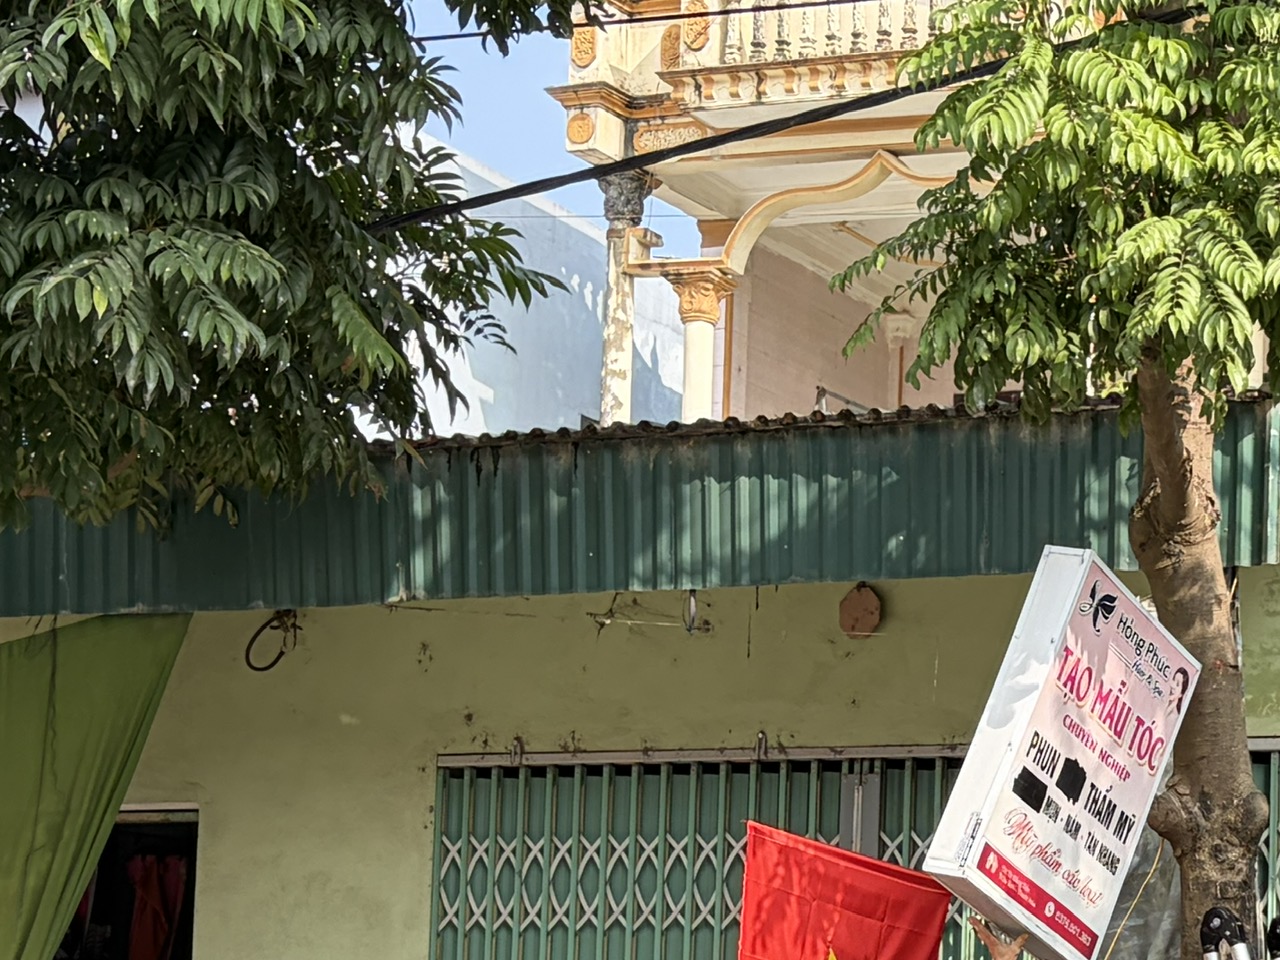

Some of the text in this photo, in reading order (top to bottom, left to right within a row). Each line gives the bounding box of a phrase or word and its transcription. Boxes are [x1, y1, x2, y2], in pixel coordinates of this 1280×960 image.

[1056, 647, 1165, 771] TẠO MẪU TÓC
[1026, 730, 1137, 845] PHUN THẨM MỸ
[1098, 748, 1131, 782] NGHIỆP
[1062, 869, 1081, 889] các
